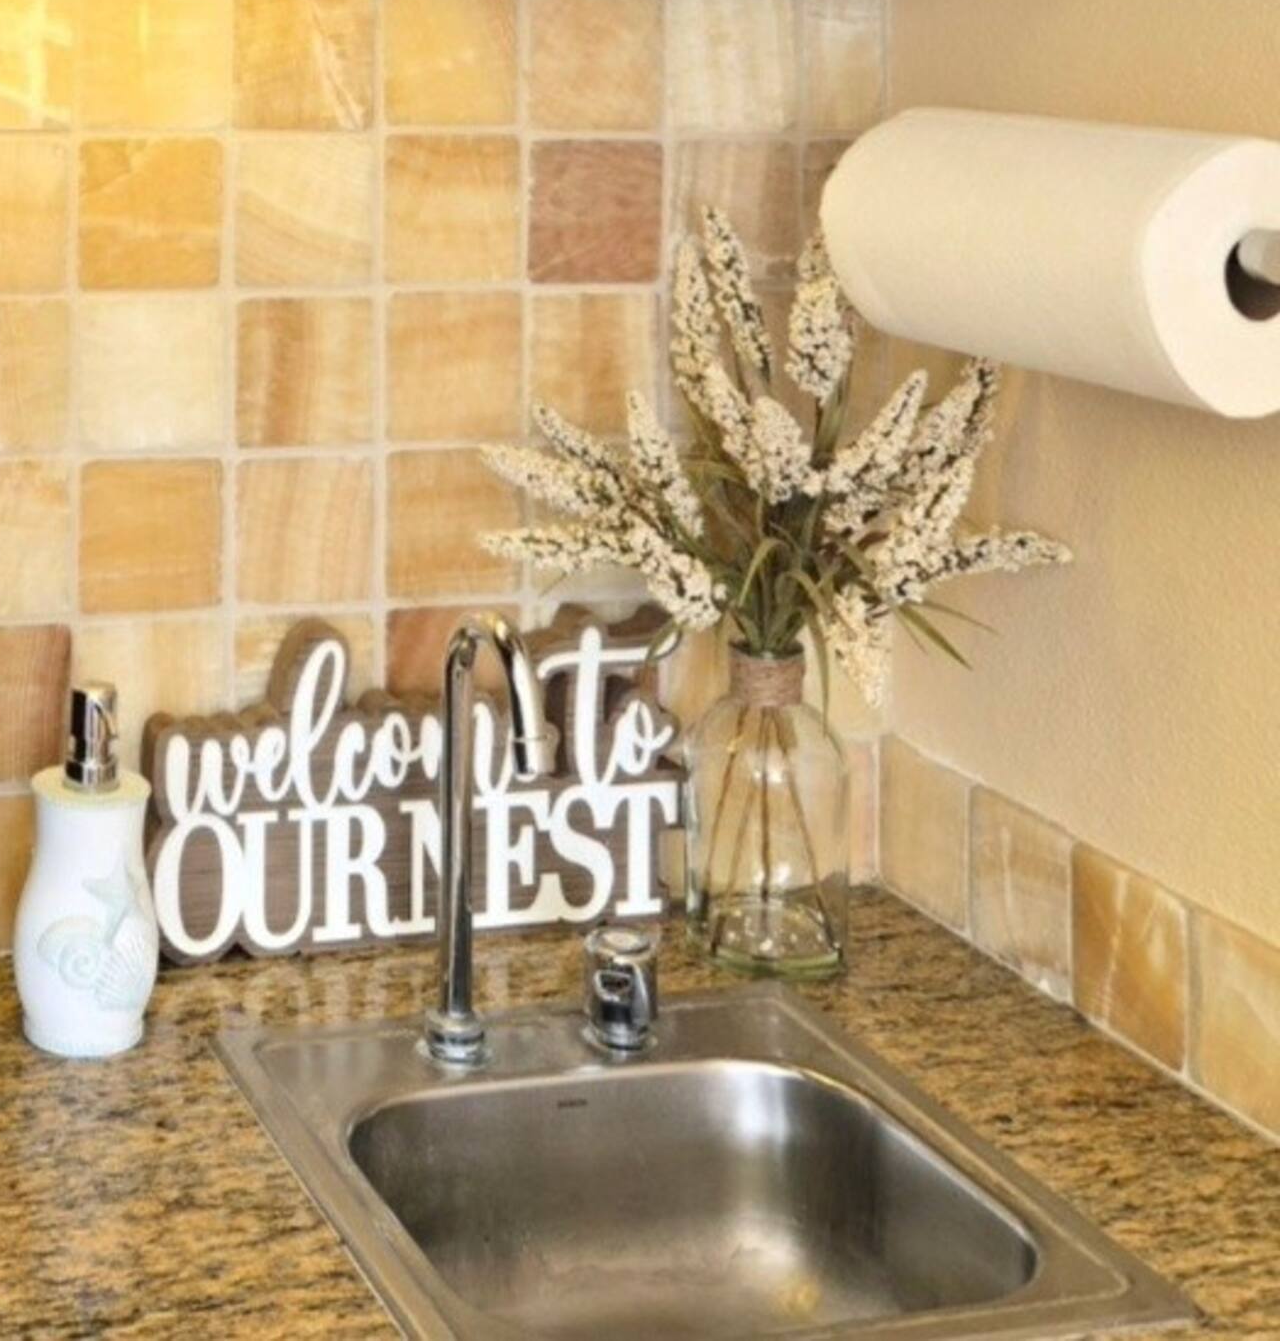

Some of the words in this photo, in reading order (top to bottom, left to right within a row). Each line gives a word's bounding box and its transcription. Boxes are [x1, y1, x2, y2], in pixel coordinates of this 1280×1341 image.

[166, 640, 538, 819] welcom
[537, 625, 681, 799] to
[154, 803, 404, 957] OUR
